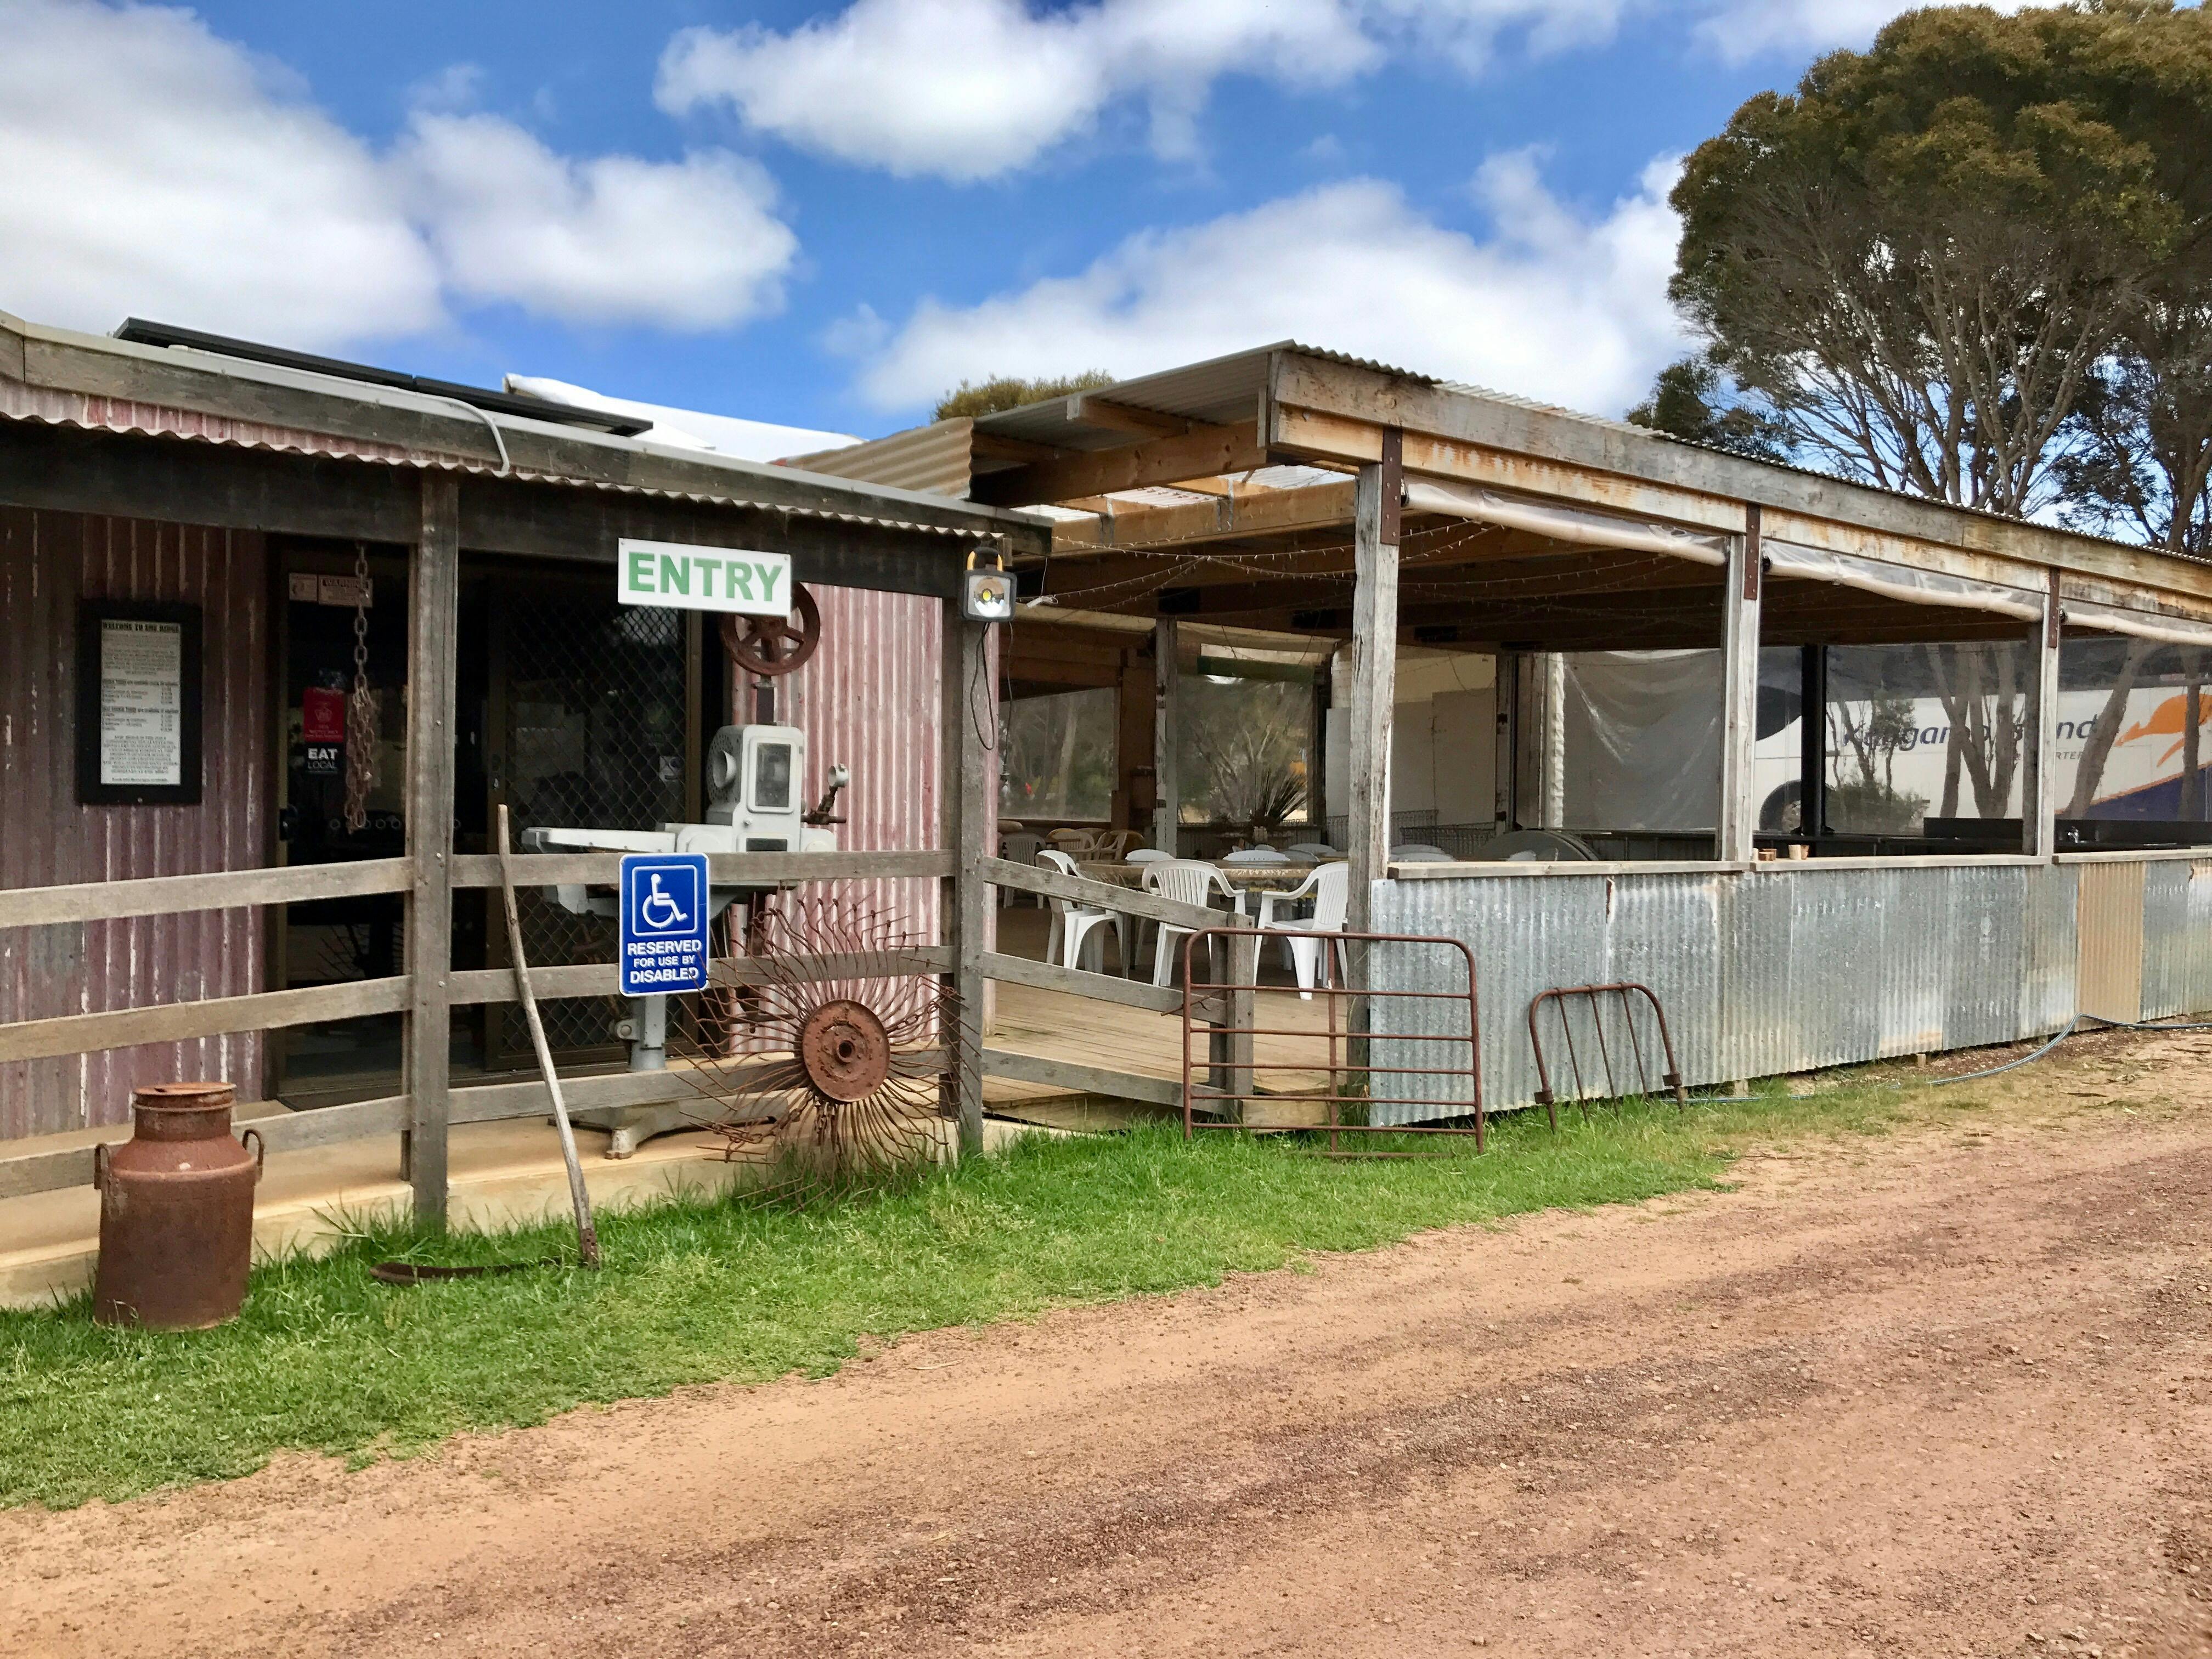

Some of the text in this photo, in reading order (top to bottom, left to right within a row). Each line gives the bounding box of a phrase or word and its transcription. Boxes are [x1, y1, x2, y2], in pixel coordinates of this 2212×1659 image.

[628, 551, 783, 602] ENTRY
[308, 748, 338, 760] EAT
[308, 760, 337, 770] LOCAL
[627, 939, 702, 956] RESERVED
[633, 955, 696, 968] FOR USE BY
[630, 968, 699, 984] DISABLED
